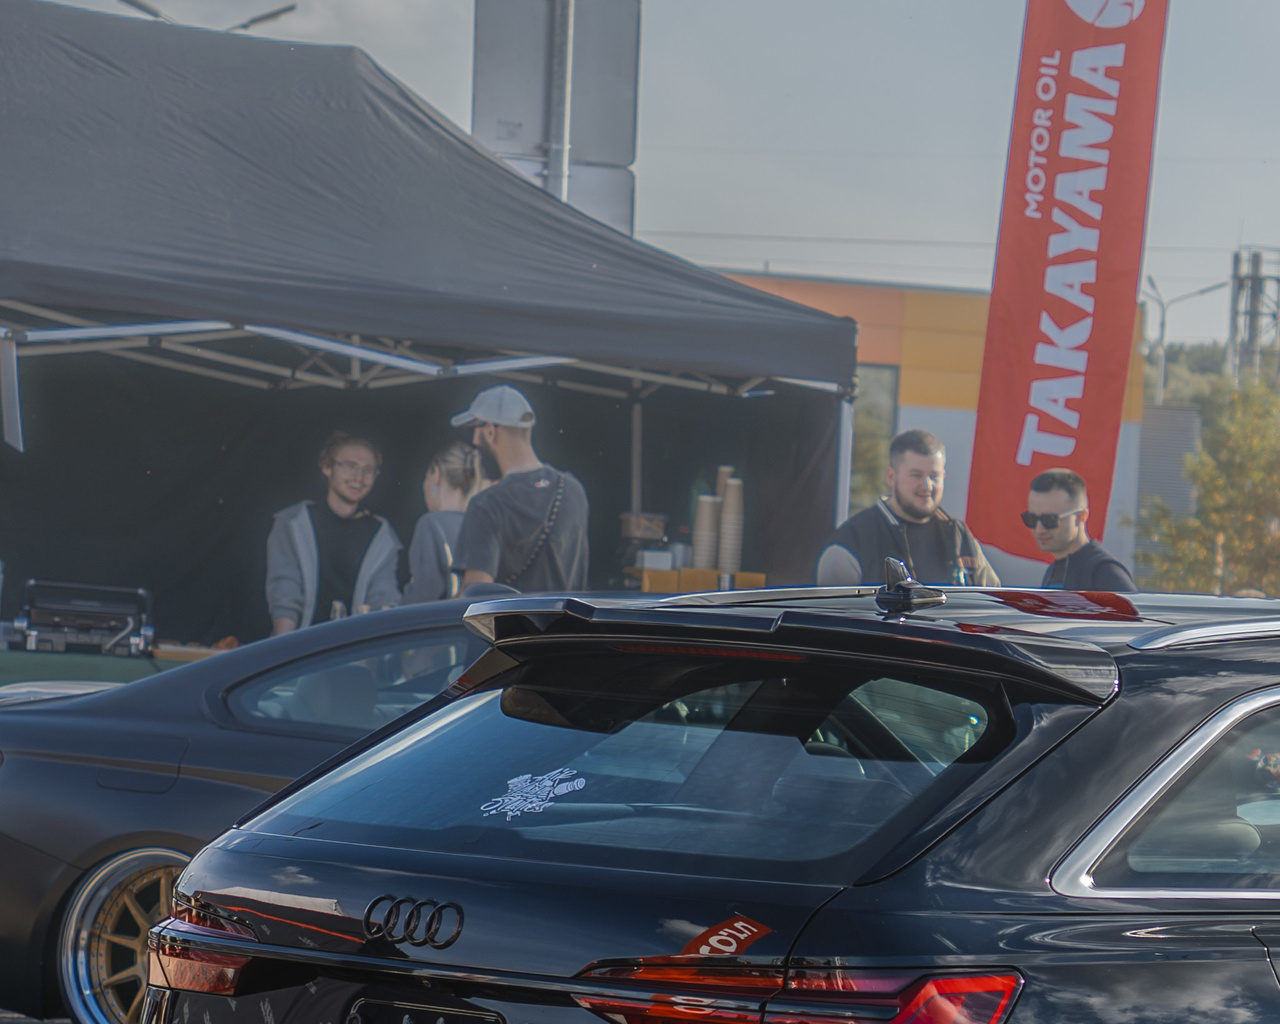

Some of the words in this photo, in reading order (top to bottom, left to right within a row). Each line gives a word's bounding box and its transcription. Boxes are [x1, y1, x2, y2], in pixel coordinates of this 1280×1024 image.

[1035, 50, 1061, 101] OIL
[1024, 107, 1054, 219] MOTOR
[1016, 42, 1127, 466] TAKAYAMA
